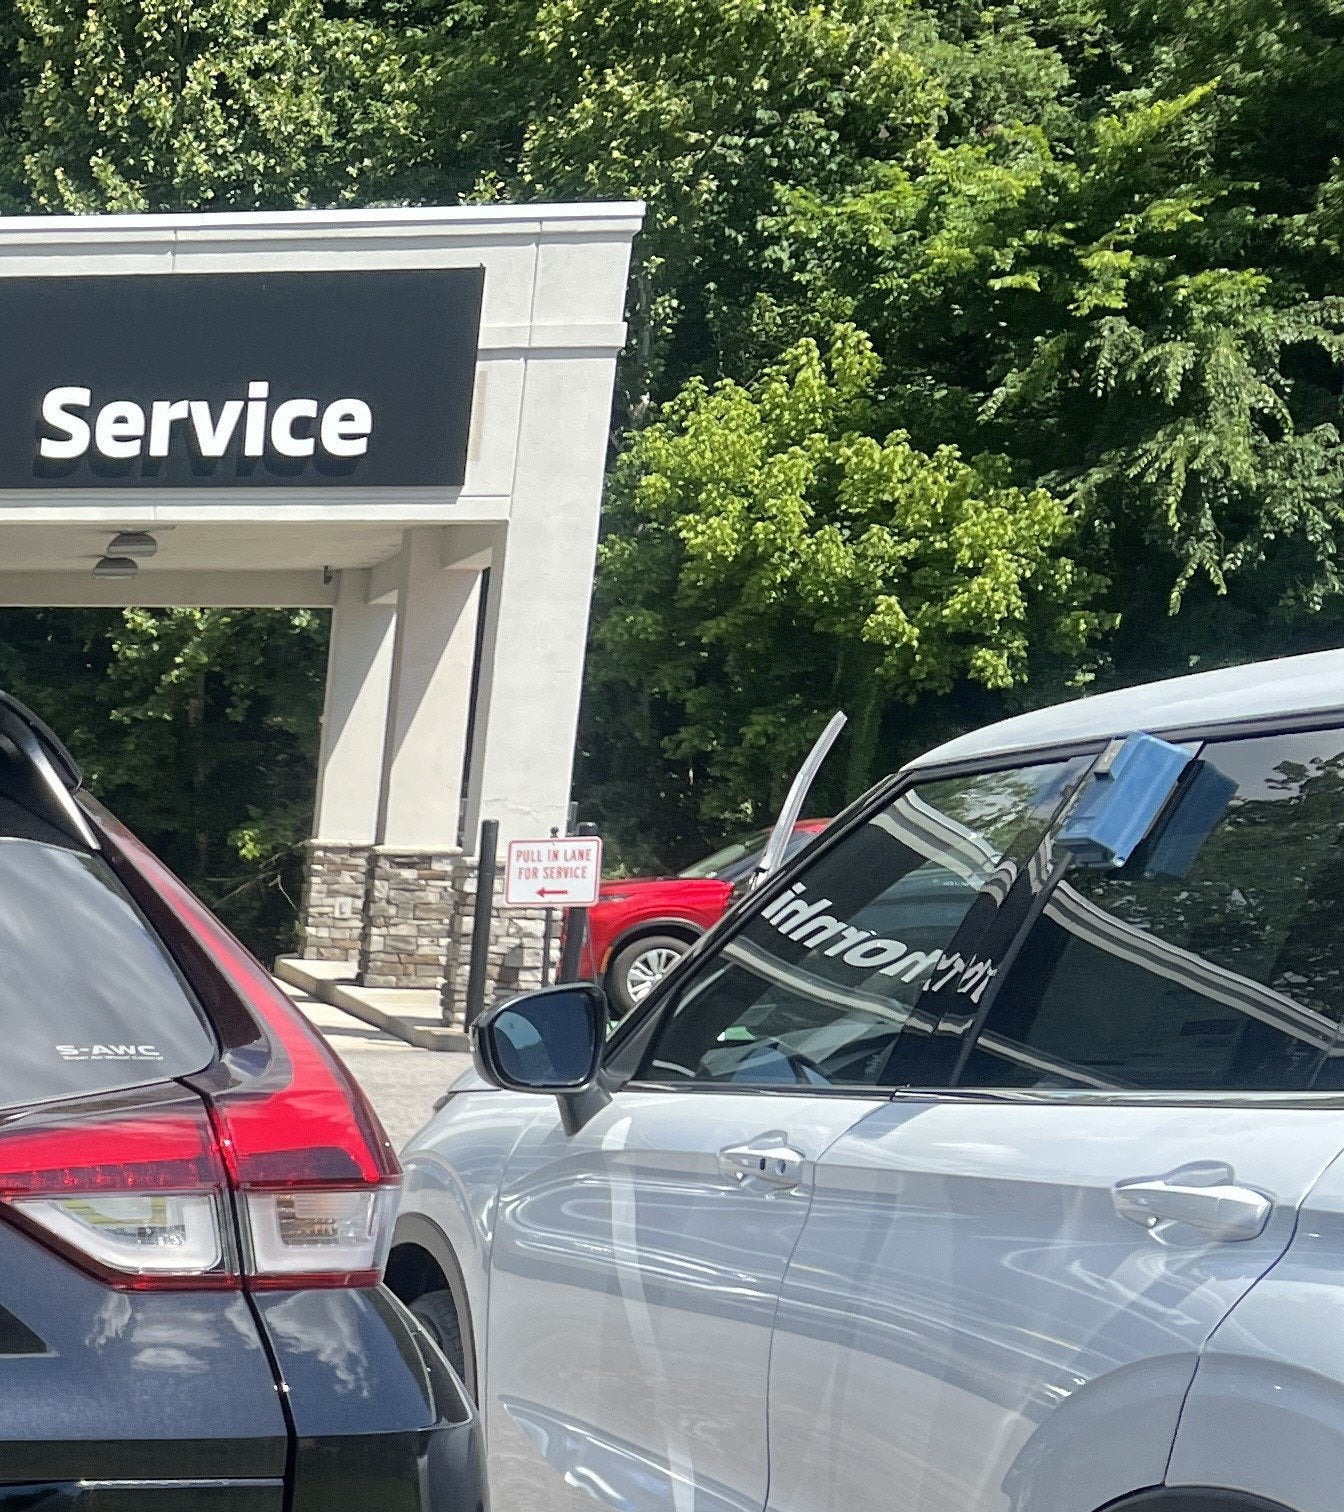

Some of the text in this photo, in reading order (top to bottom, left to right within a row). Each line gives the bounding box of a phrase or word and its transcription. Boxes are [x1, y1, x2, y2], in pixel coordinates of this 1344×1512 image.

[39, 381, 372, 459] Service
[516, 848, 592, 862] PULL IN LANE
[518, 866, 588, 879] FOR SERVICE
[55, 1044, 160, 1057] S-AWC
